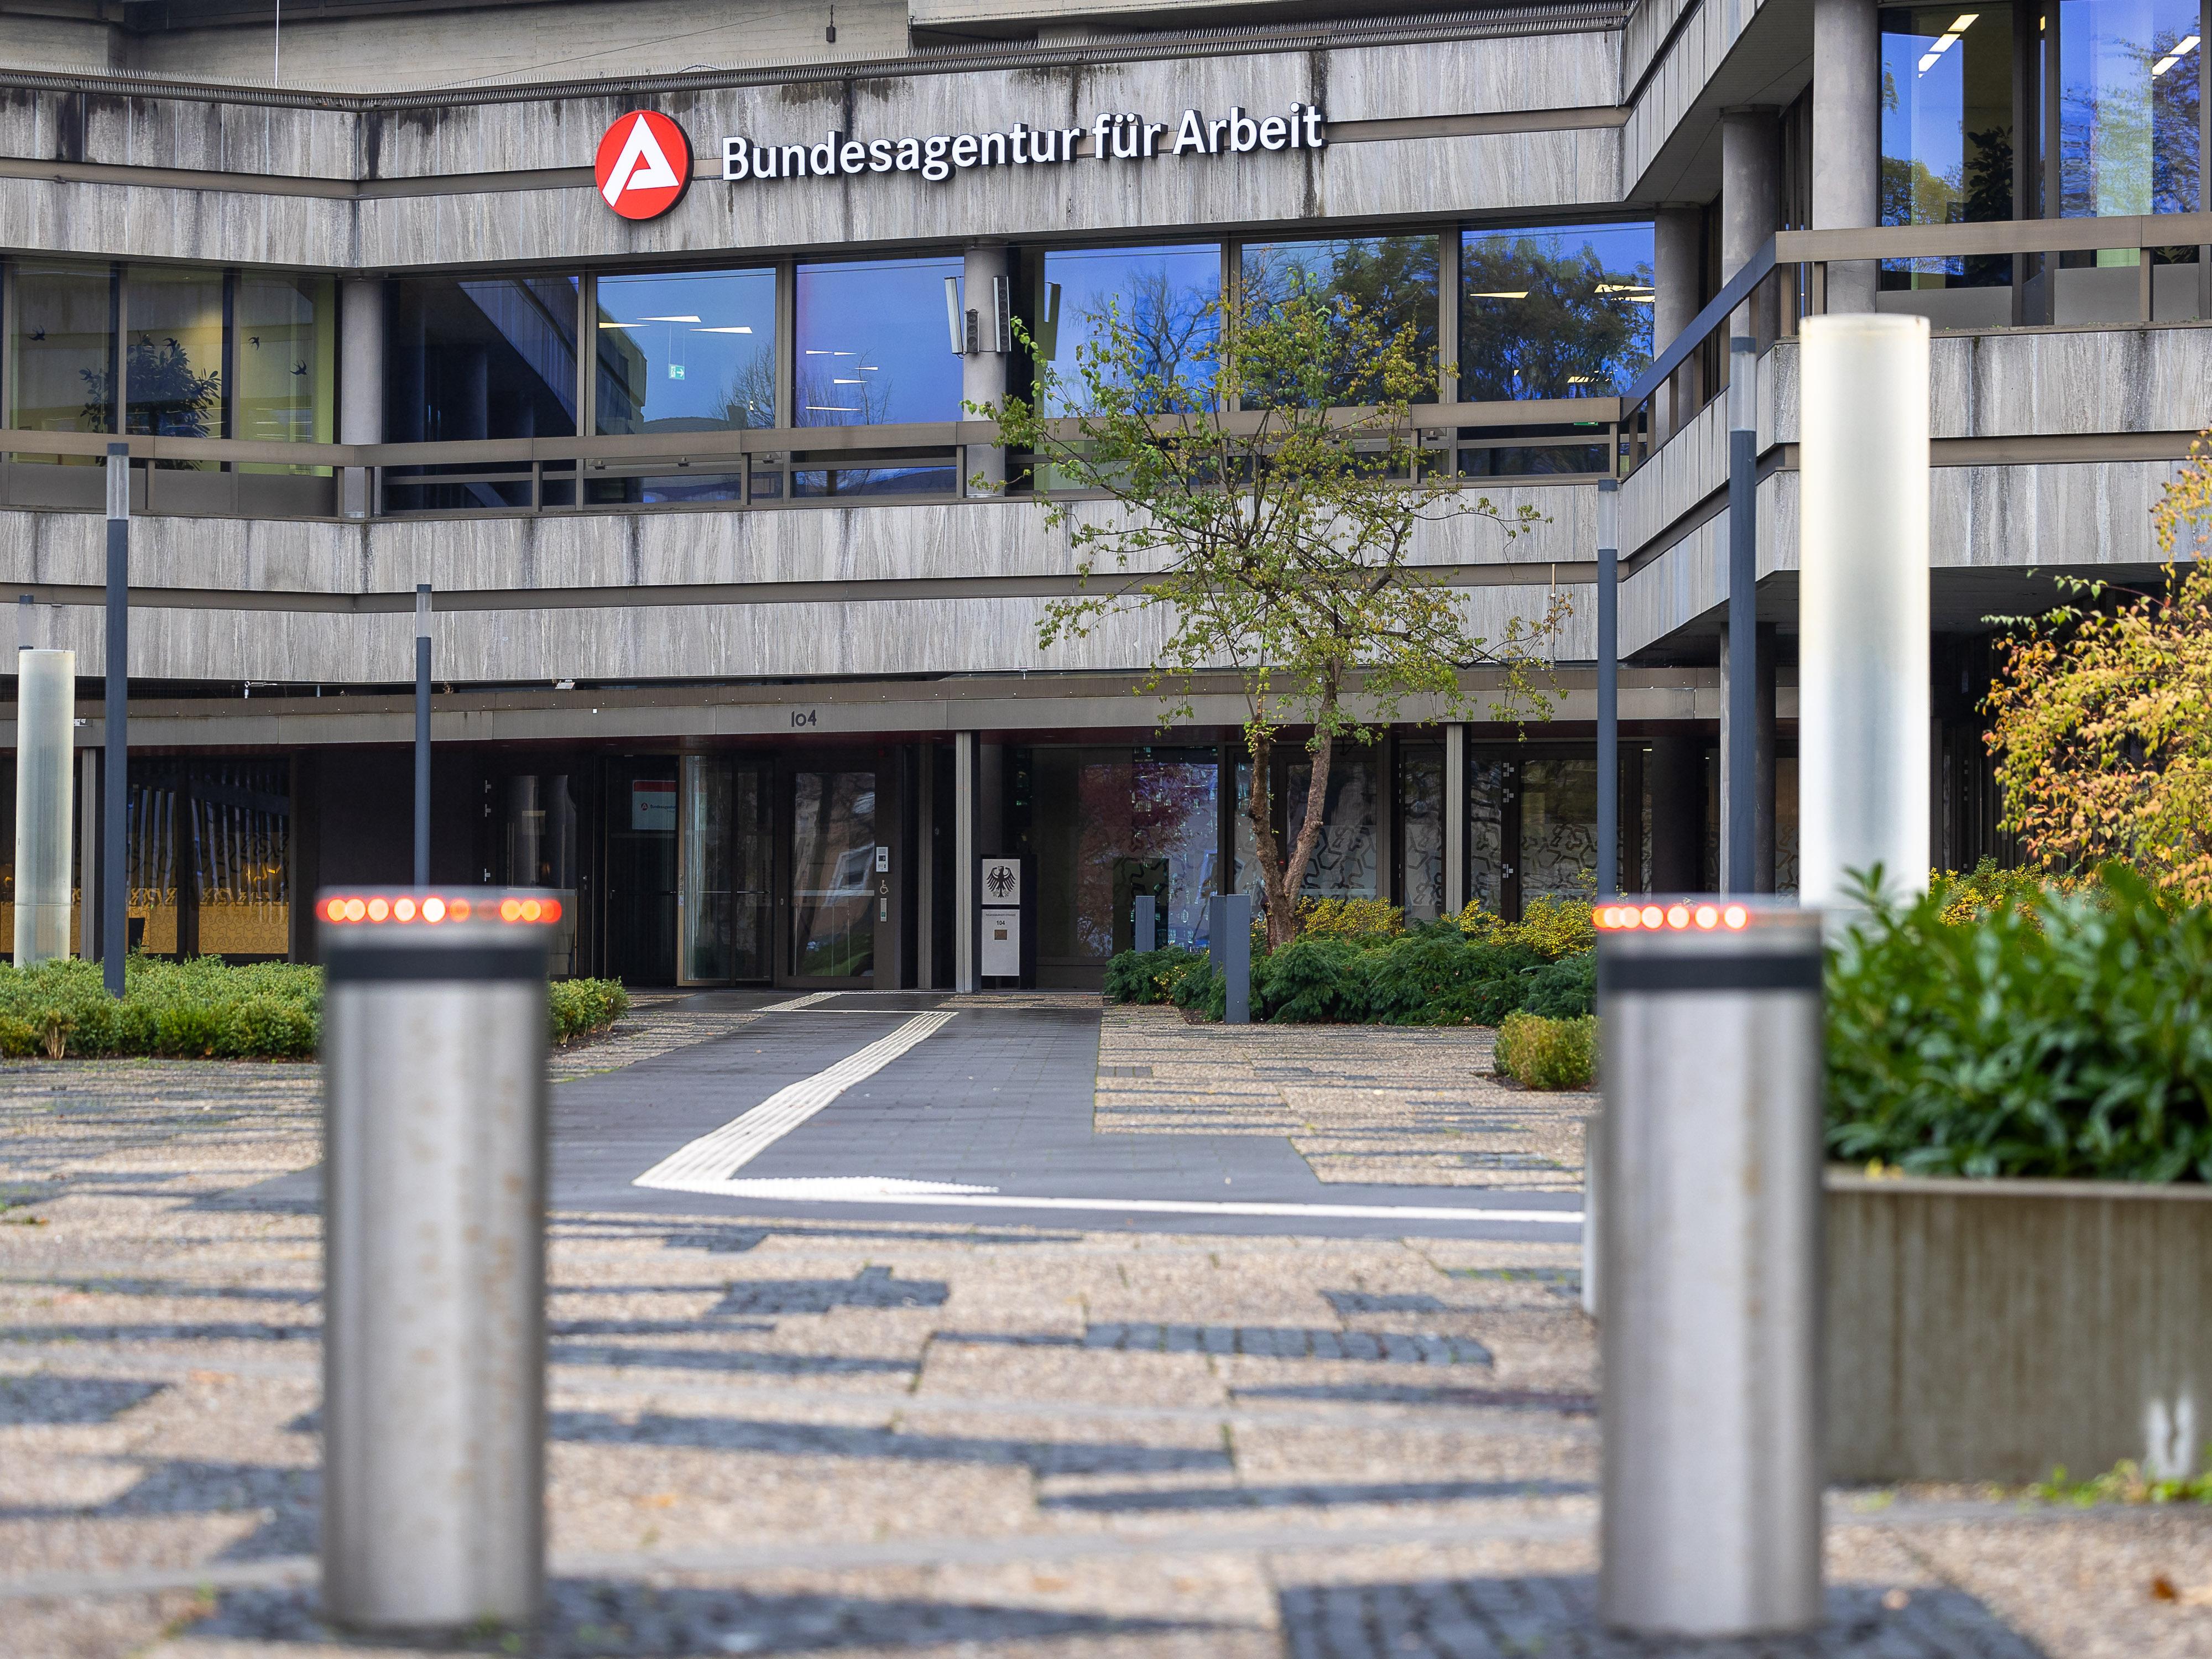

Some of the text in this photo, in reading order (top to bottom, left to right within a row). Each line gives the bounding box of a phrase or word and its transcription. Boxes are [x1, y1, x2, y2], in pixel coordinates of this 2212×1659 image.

[722, 102, 1323, 182] Bundesagentur für Arbeit
[791, 709, 817, 728] 104
